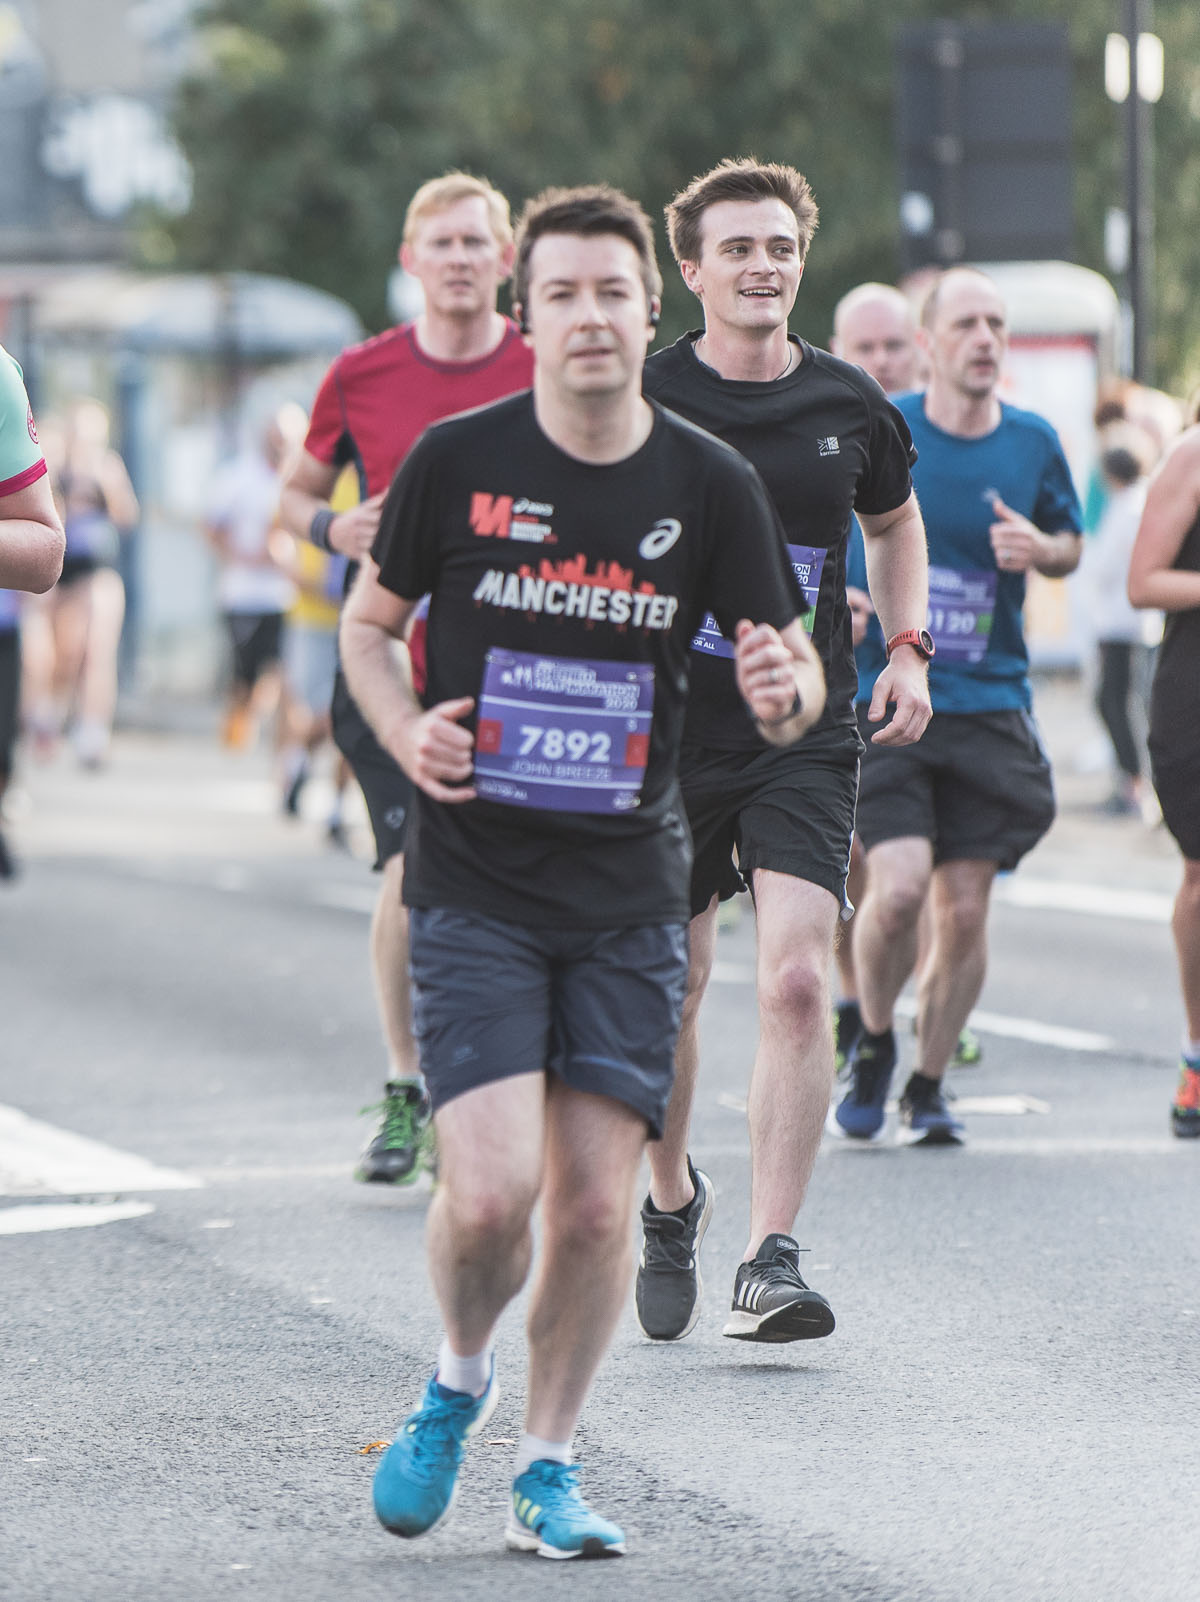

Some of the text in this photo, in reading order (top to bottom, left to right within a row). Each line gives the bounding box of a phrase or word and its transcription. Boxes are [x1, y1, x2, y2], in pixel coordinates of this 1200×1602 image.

[473, 569, 678, 630] MANCHESTER
[704, 640, 715, 650] ALL
[518, 725, 612, 763] 7892
[511, 759, 612, 781] JOHN BREEZE
